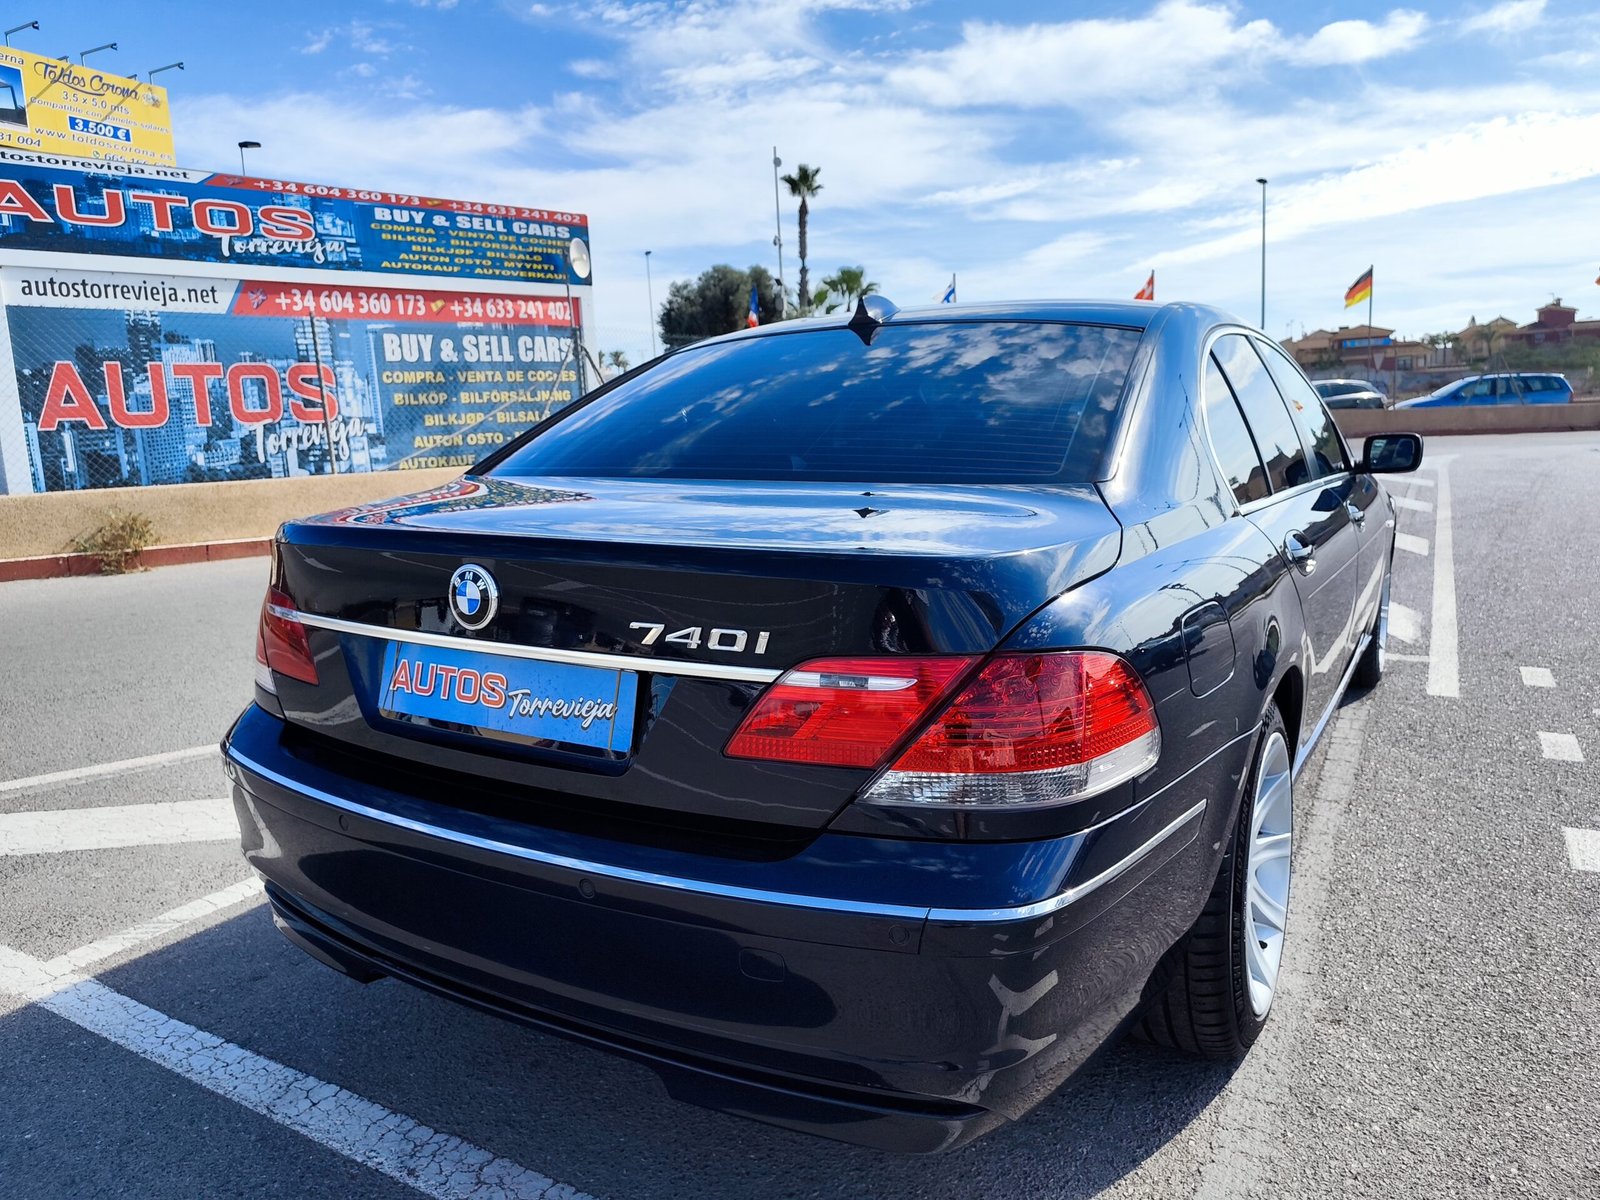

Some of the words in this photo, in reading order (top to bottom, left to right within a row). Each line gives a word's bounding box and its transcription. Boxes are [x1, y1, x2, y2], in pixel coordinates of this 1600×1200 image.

[34, 61, 86, 88] Toldos
[90, 75, 140, 101] Corona
[30, 96, 83, 113] Compatible
[86, 110, 102, 118] con
[106, 115, 137, 127] paneles
[141, 123, 169, 134] solares
[74, 118, 114, 137] 3.500
[117, 129, 127, 140] €
[17, 135, 41, 147] 004
[0, 179, 315, 241] AUTOS
[253, 180, 298, 192] +34
[303, 184, 341, 197] 604
[347, 189, 382, 201] 360
[388, 194, 420, 206] 173
[448, 201, 483, 212] +34
[487, 205, 516, 216] 633
[521, 209, 549, 219] 241
[553, 212, 580, 223] 402
[370, 223, 435, 235] COMPRA
[448, 230, 495, 240] VENTA
[499, 234, 517, 242] DE
[374, 207, 425, 224] BUY
[432, 215, 450, 227] &
[456, 215, 507, 233] SELL
[512, 221, 570, 239] CARS
[213, 234, 345, 265] Torrevieja
[399, 252, 450, 263] AUTON
[454, 257, 492, 266] OSTO
[504, 261, 555, 271] MYYNTI
[381, 261, 461, 272] AUTOKAUF
[21, 277, 219, 306] autostorrevieja.net
[275, 288, 316, 312] +34
[320, 290, 354, 313] 604
[358, 292, 391, 314] 360
[395, 294, 426, 316] 173
[450, 297, 483, 317] +34
[486, 298, 515, 318] 633
[517, 300, 544, 319] 241
[548, 301, 571, 320] 402
[383, 333, 433, 362] BUY
[440, 338, 459, 362] &
[462, 334, 514, 363] SELL
[518, 335, 575, 362] CARS
[382, 370, 445, 384] COMPRA
[457, 370, 503, 383] VENTA
[506, 370, 524, 382] DE
[38, 361, 338, 431] AUTOS
[249, 415, 365, 463] Torrevieja
[414, 434, 463, 449] AUTON
[466, 432, 504, 445] OSTO
[399, 454, 476, 470] AUTOKAUF
[454, 571, 487, 591] BMW
[390, 658, 507, 709] AUTOS
[507, 688, 616, 729] Torrevieja
